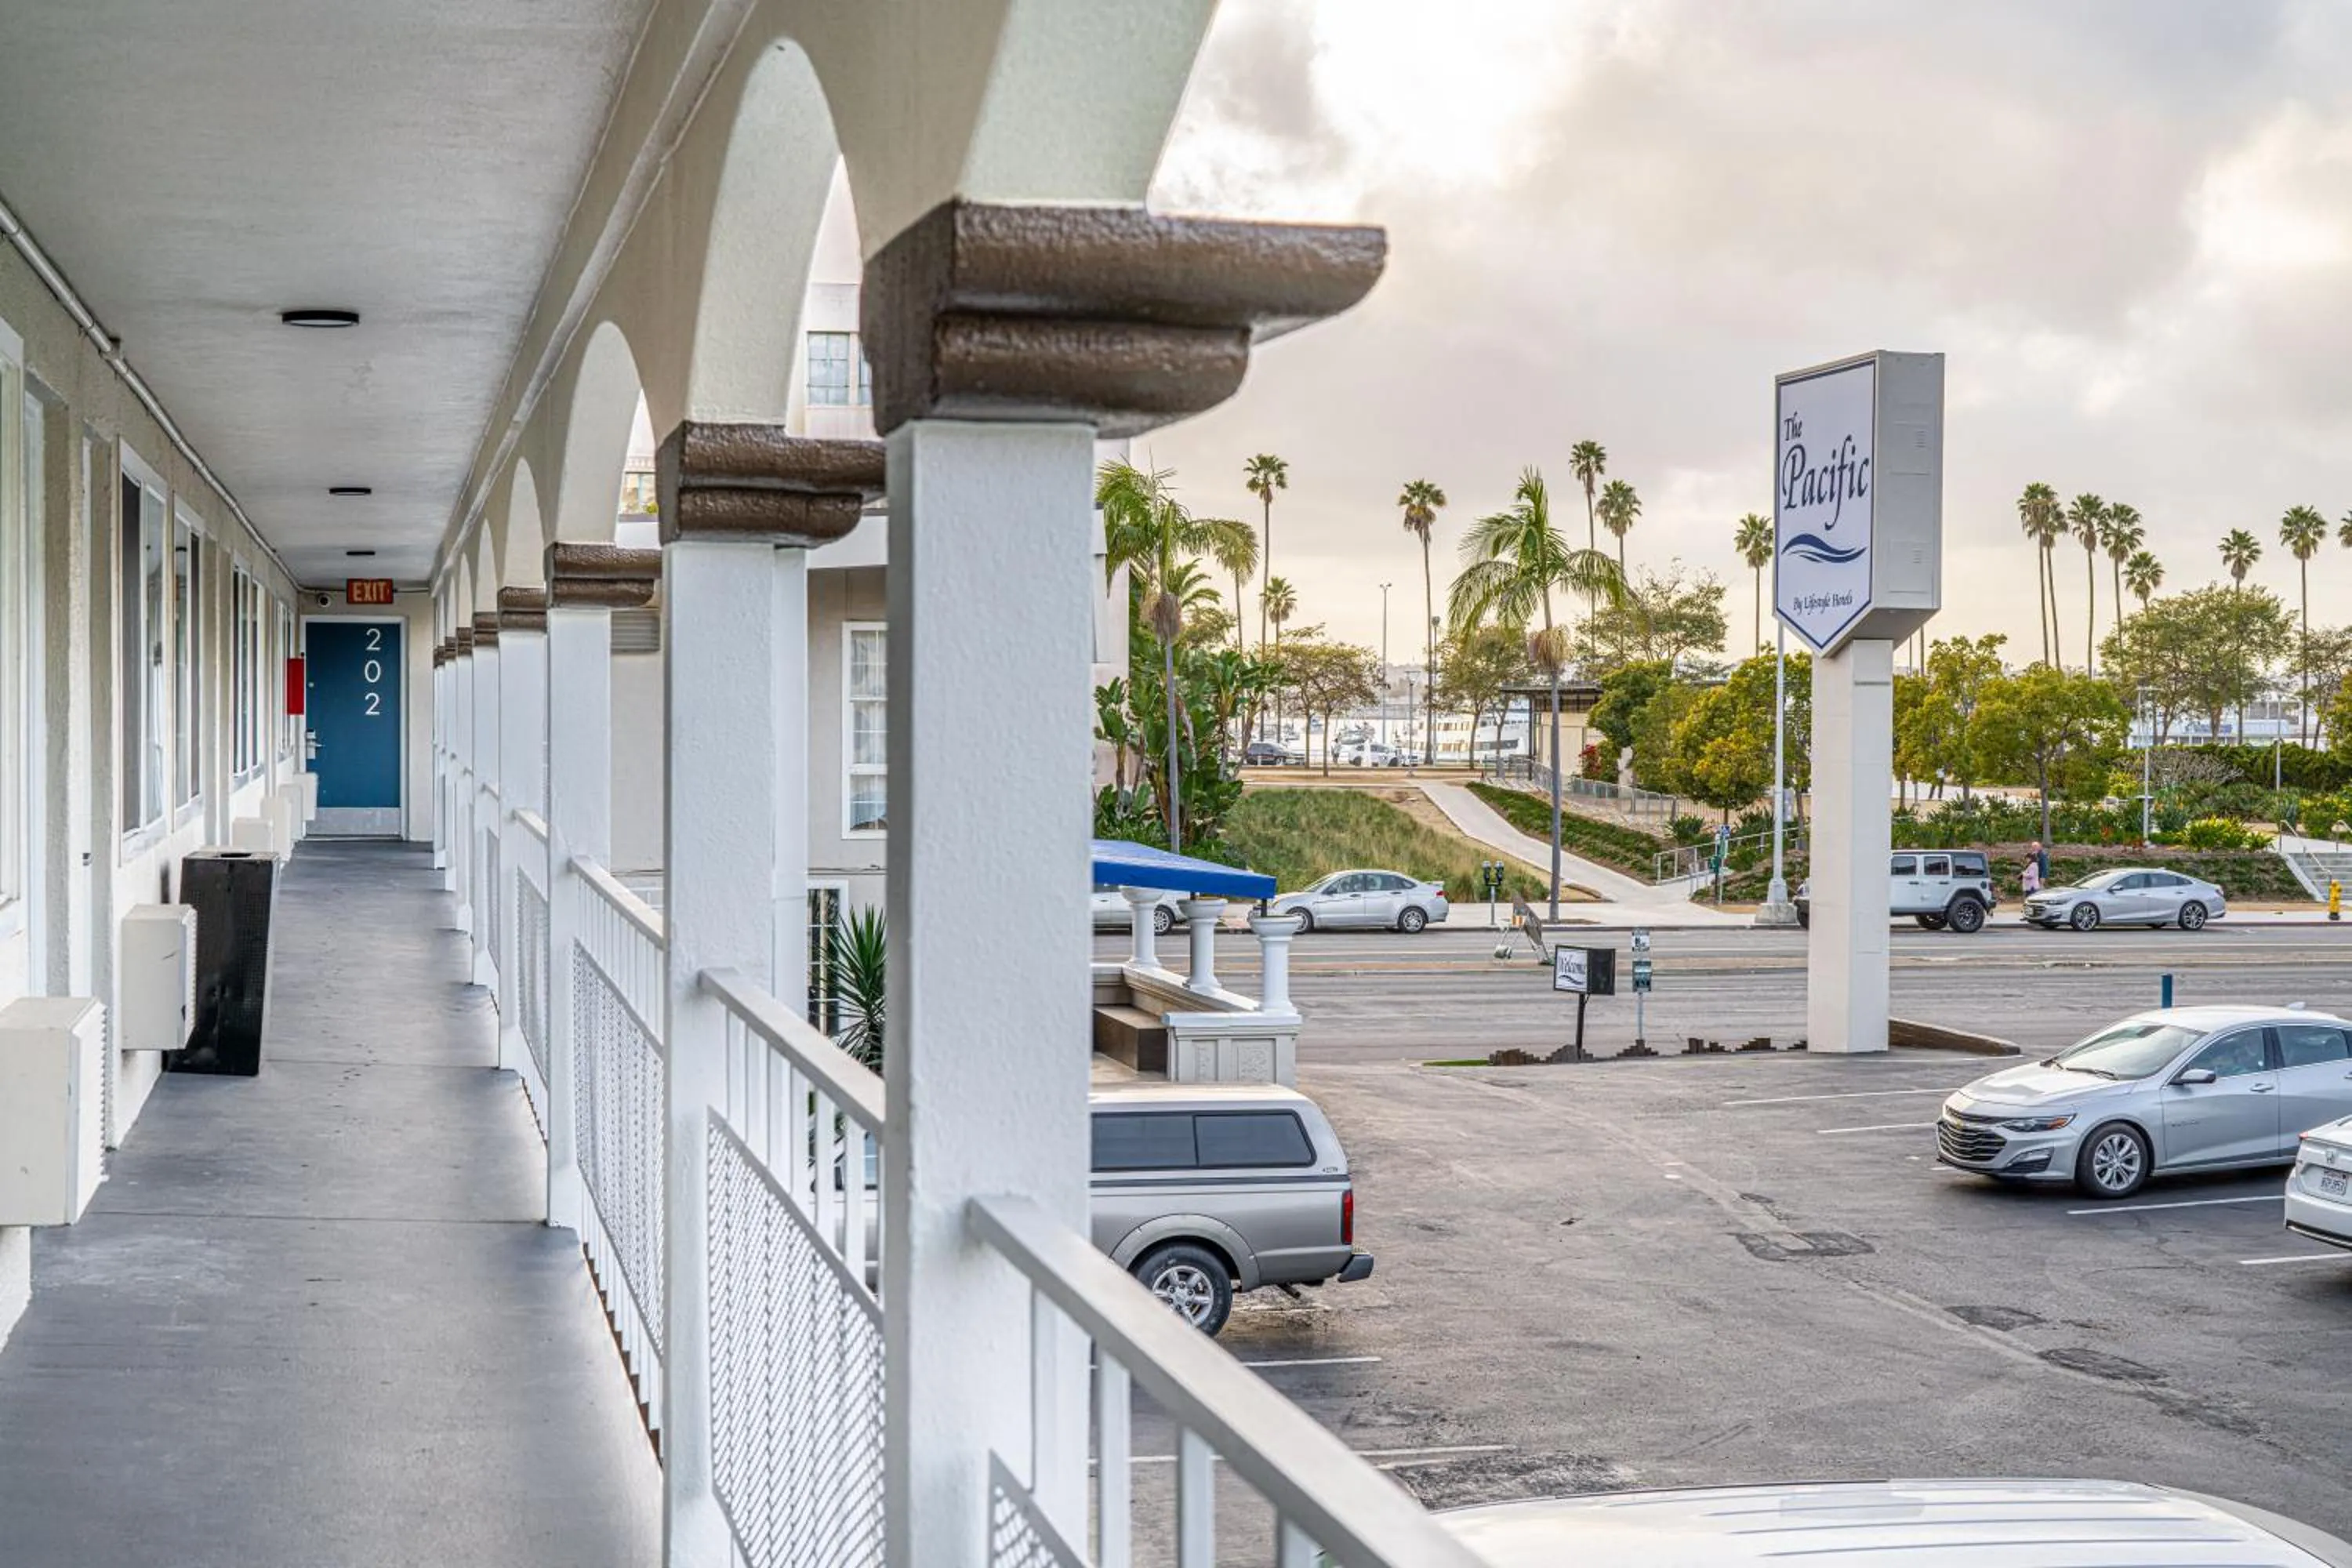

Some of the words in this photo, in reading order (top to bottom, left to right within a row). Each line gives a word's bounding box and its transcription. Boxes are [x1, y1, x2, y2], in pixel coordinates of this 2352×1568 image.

[1784, 411, 1802, 441] The
[1782, 434, 1870, 531] Pacific
[352, 582, 387, 602] EXIT
[364, 628, 382, 716] 202
